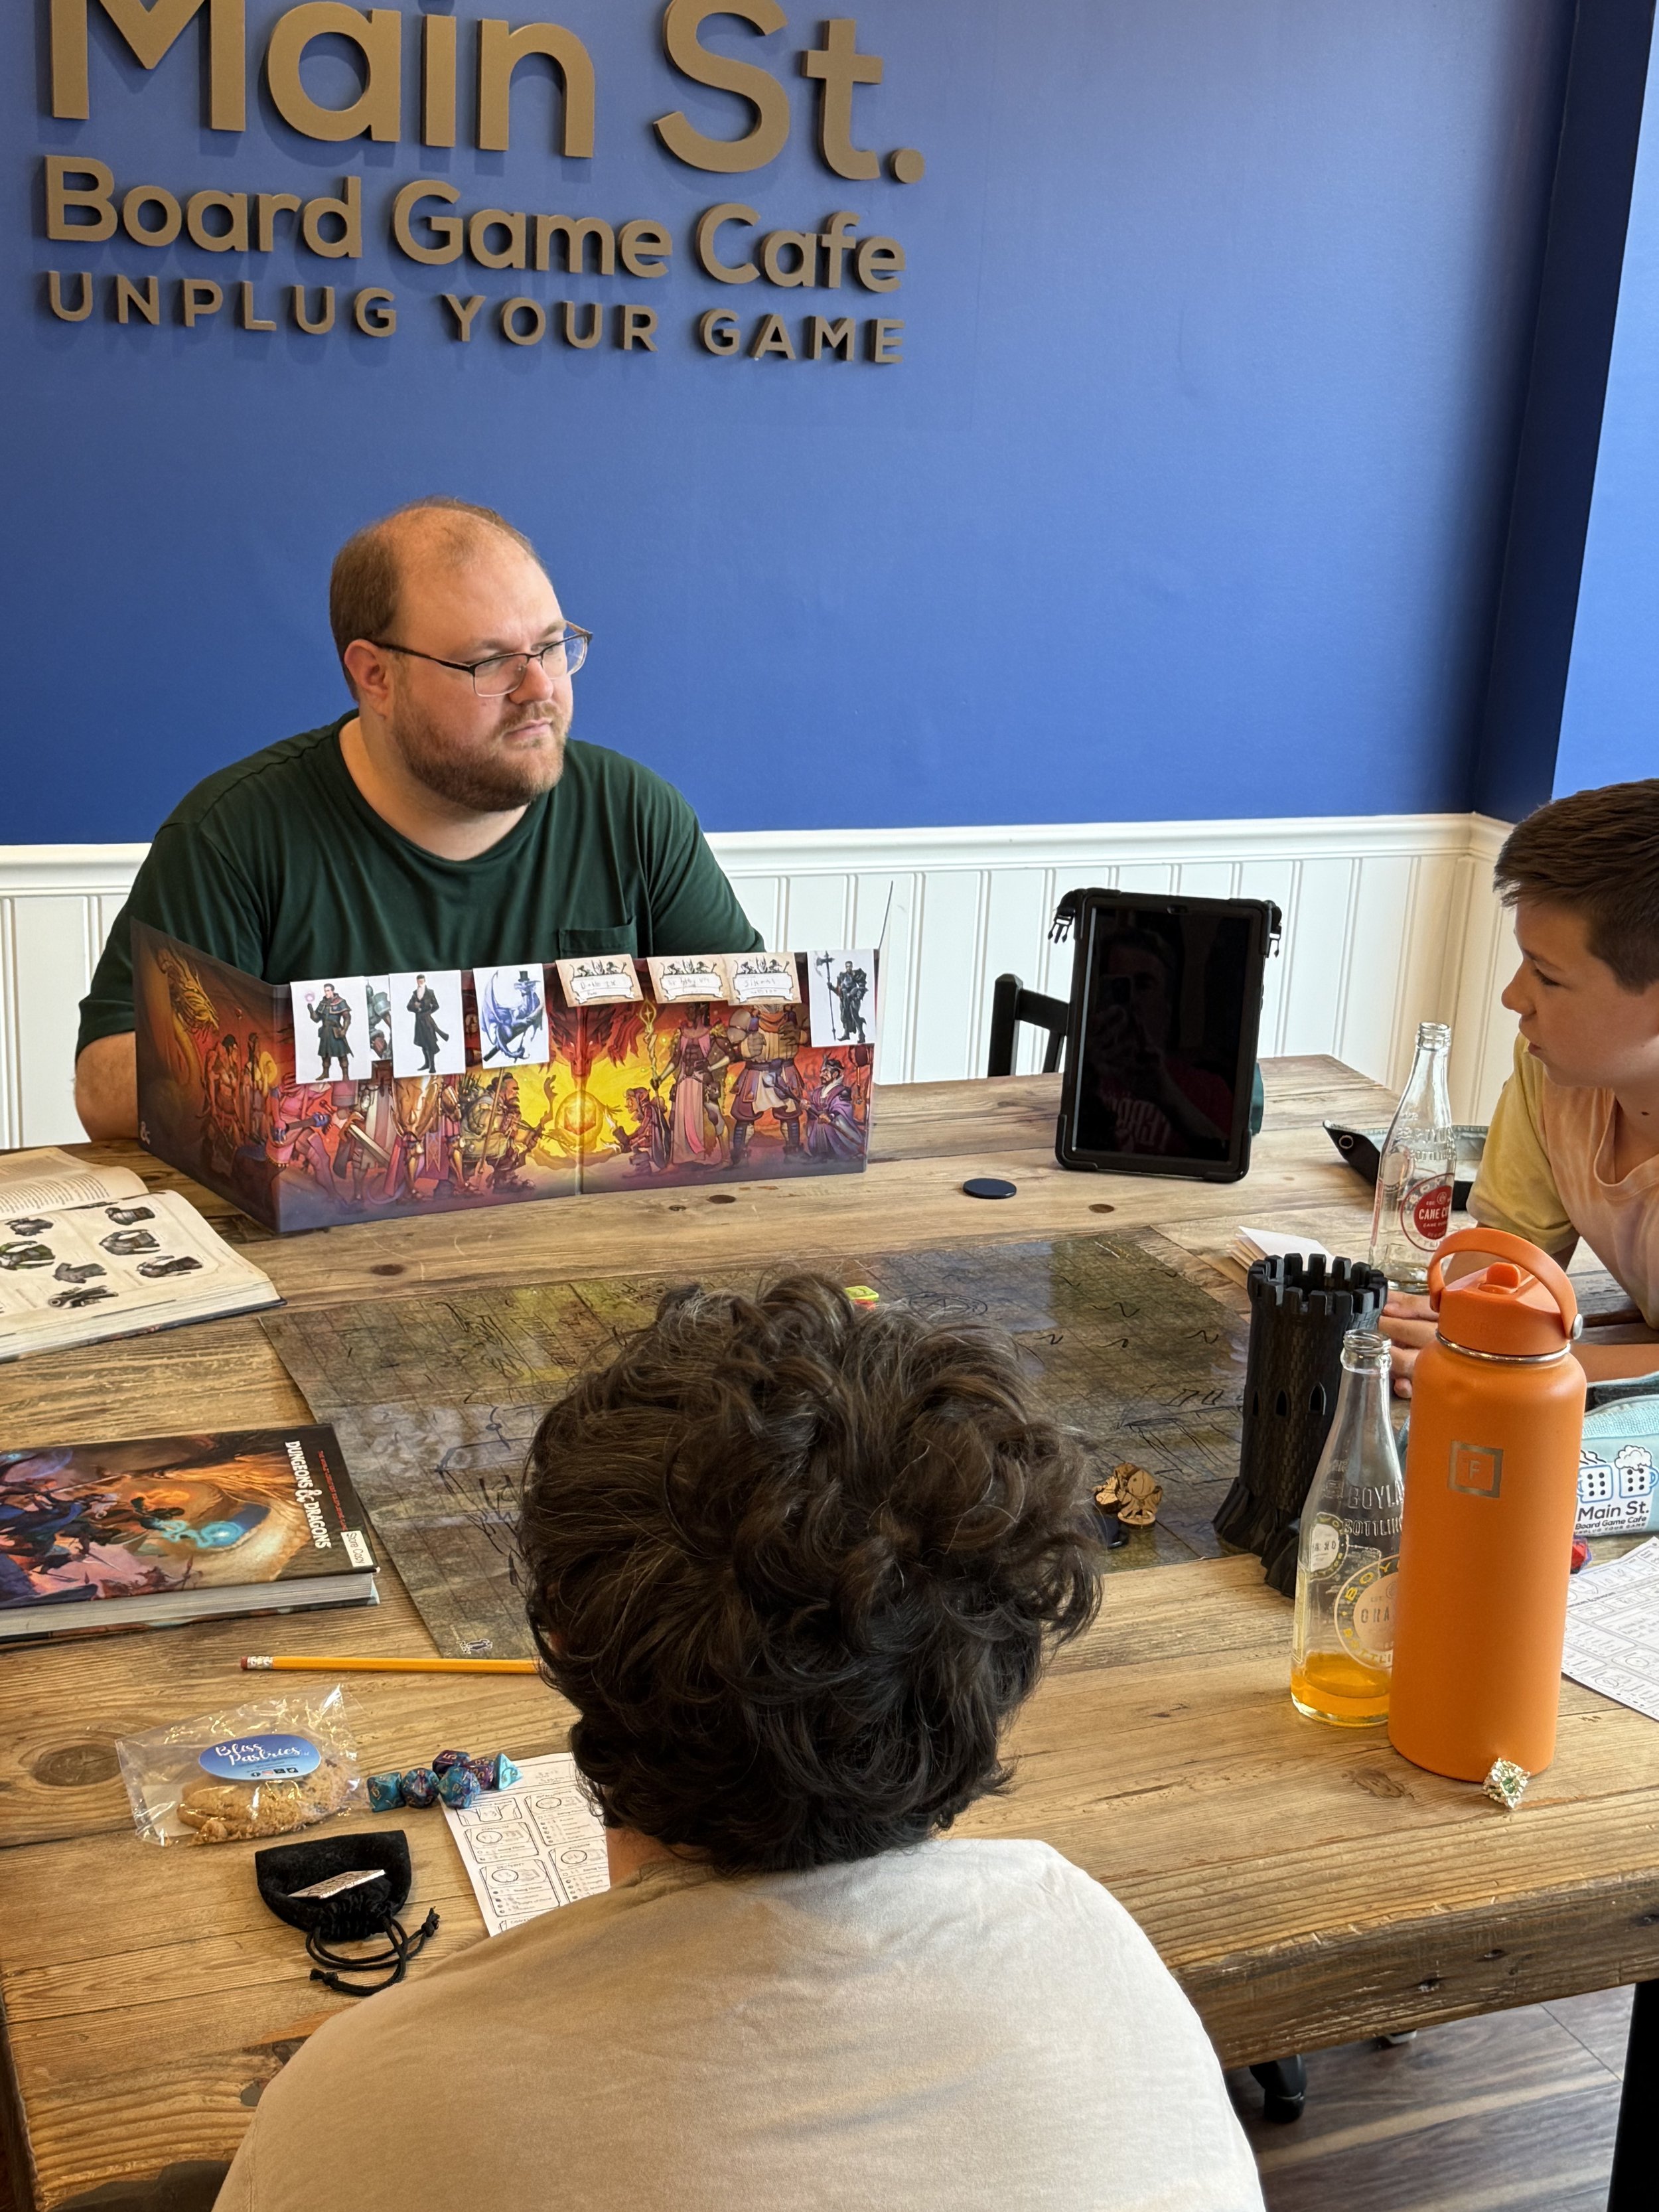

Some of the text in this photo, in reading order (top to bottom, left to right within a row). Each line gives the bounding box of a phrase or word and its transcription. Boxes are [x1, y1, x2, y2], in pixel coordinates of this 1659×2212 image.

[50, 0, 924, 184] Main St.
[46, 155, 906, 293] Board Game Cafe
[48, 271, 905, 364] UNPLUG YOUR GAME
[1419, 1209, 1439, 1220] CANE
[285, 1440, 332, 1549] DUNGEONS & DRAGONS
[1577, 1501, 1650, 1522] Main St.
[1344, 1516, 1403, 1536] BOTTLIN
[1575, 1521, 1601, 1530] Board
[346, 1532, 366, 1564] Store Copy
[216, 1743, 262, 1757] Bliss
